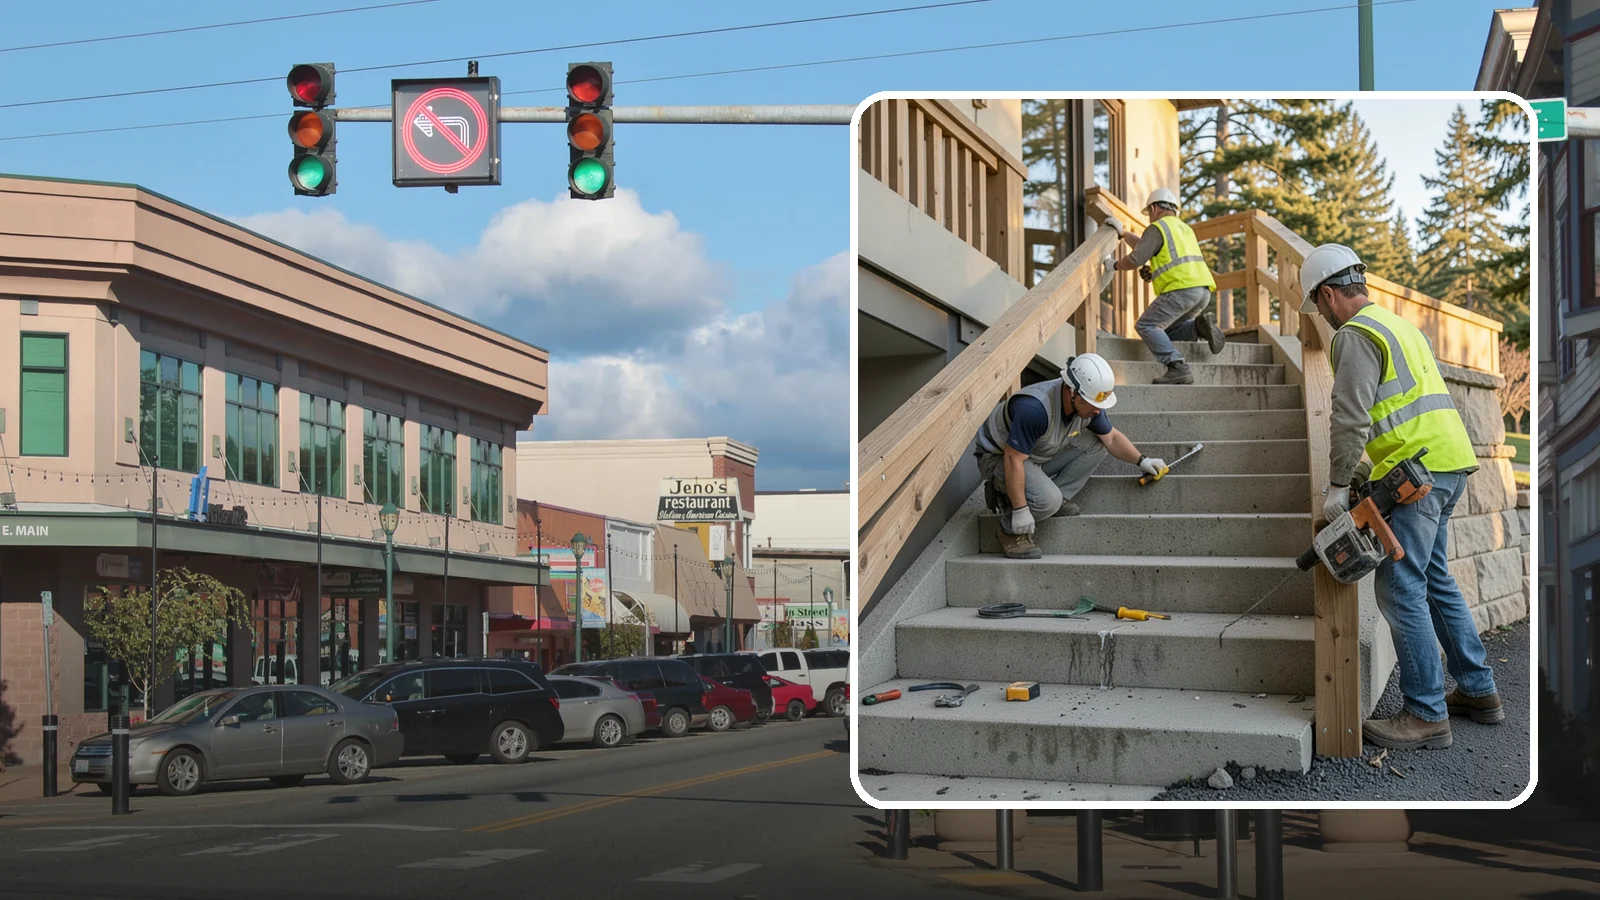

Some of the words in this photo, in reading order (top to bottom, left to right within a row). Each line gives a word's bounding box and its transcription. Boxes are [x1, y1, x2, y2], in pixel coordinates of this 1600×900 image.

[669, 480, 728, 494] Jeno's
[665, 496, 731, 509] restaurant
[658, 510, 681, 519] Italian
[686, 509, 714, 519] American
[715, 509, 738, 519] Cuisine
[2, 525, 13, 536] E.
[15, 525, 49, 536] MAIN
